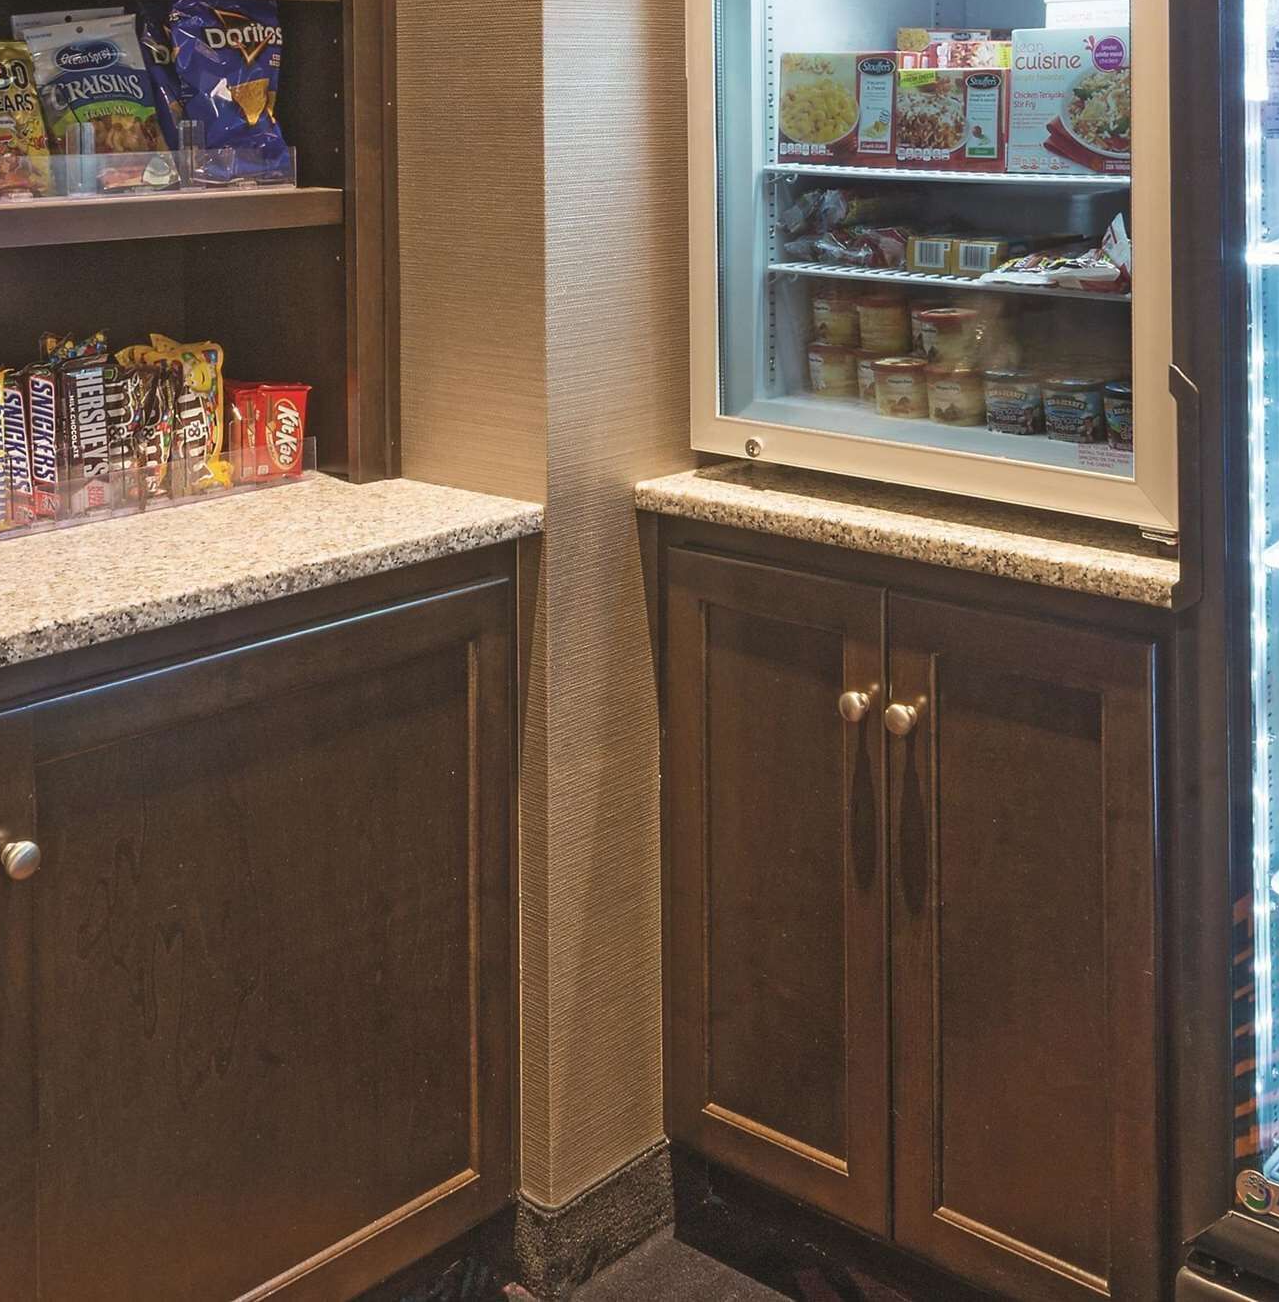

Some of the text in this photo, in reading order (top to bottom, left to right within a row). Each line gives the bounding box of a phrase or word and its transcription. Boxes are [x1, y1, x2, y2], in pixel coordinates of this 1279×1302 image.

[88, 49, 113, 64] Spray
[205, 25, 283, 49] Doritos
[1015, 52, 1082, 70] cuisine
[50, 74, 145, 109] CRAISINS
[4, 392, 32, 494] SNICKERS
[31, 378, 55, 482] SNICKERS
[70, 414, 79, 459] CHOCOLATE
[75, 370, 110, 478] HERSHEY'S
